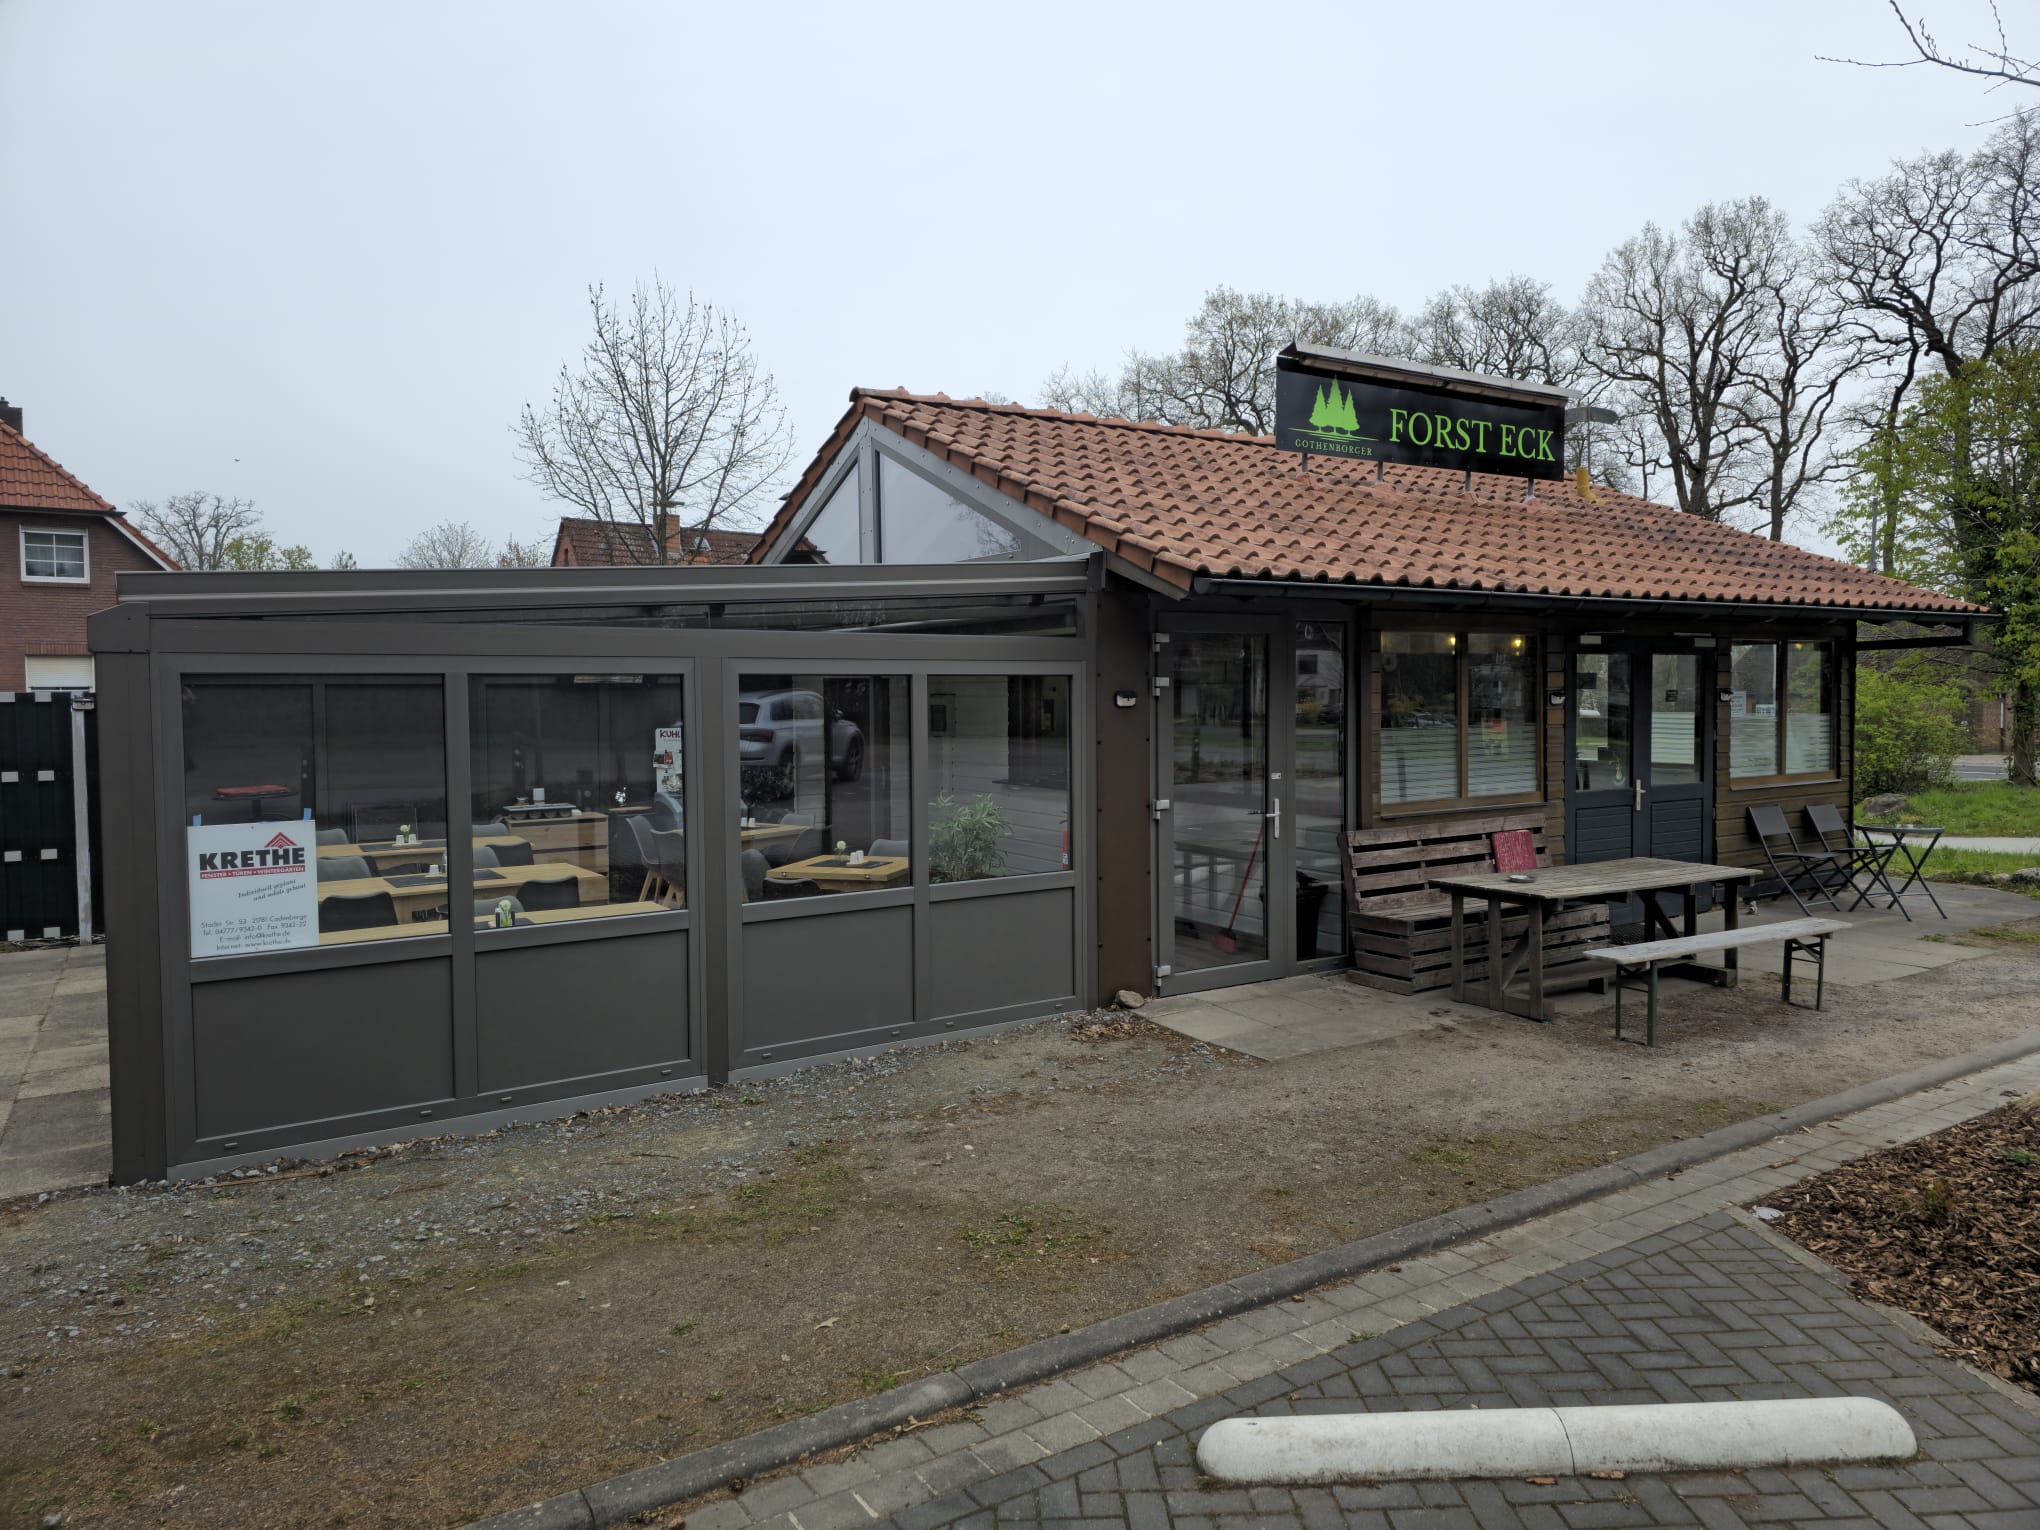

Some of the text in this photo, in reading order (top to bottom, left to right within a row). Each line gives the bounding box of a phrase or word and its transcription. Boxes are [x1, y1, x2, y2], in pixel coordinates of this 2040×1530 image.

[1389, 408, 1556, 462] FORST ECK
[200, 848, 305, 871] KRETHE
